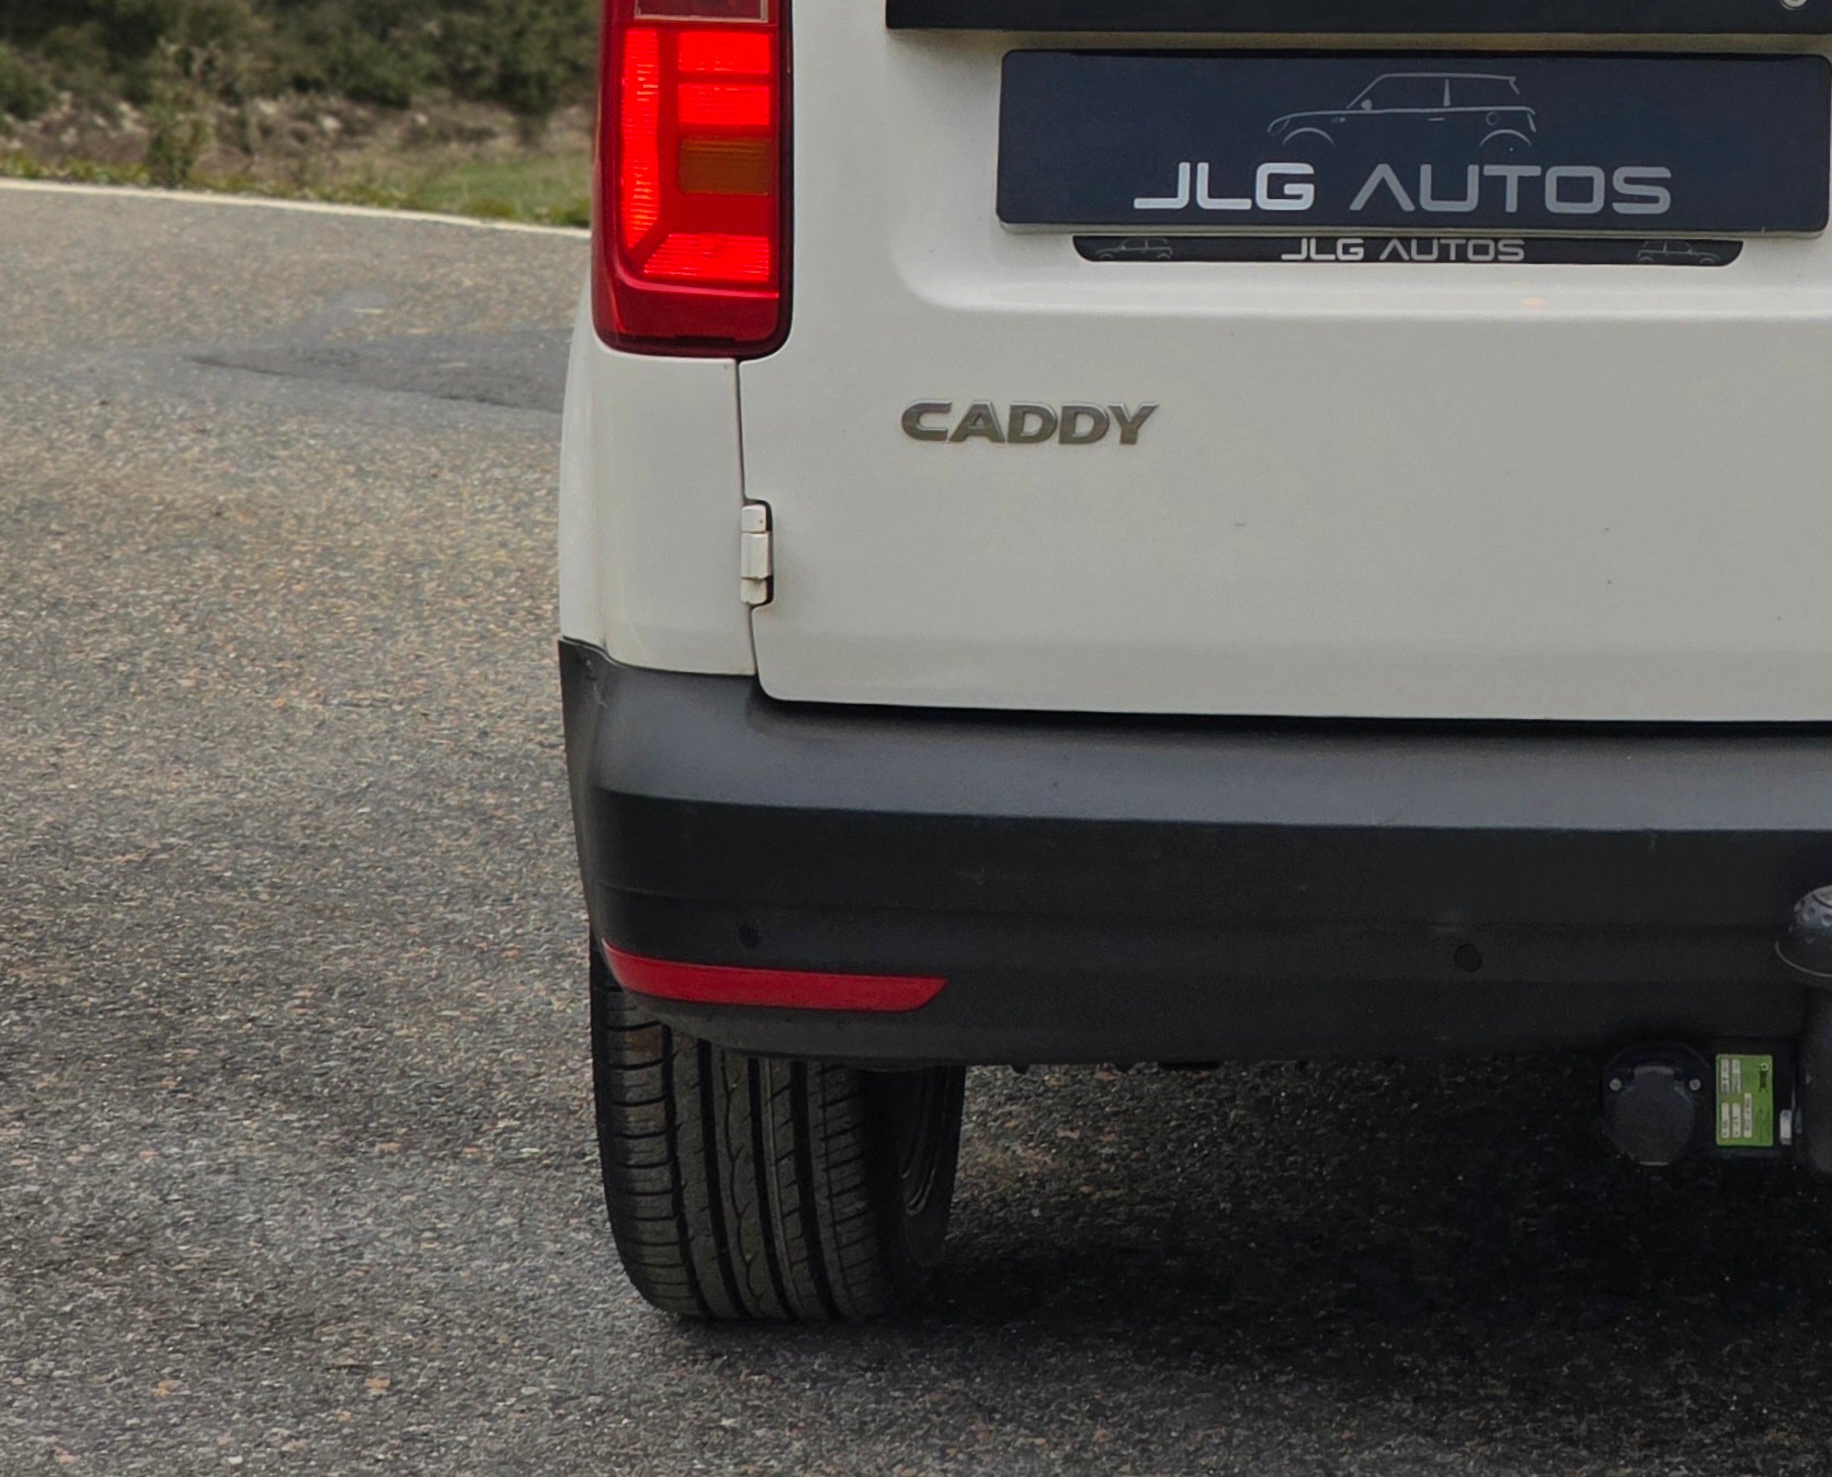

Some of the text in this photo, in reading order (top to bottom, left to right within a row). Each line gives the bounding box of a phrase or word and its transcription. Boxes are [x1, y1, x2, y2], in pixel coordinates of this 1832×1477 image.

[1133, 161, 1672, 215] JLG AUTOS
[1280, 237, 1525, 262] JLG AUTOS
[901, 399, 1159, 445] CADDY
